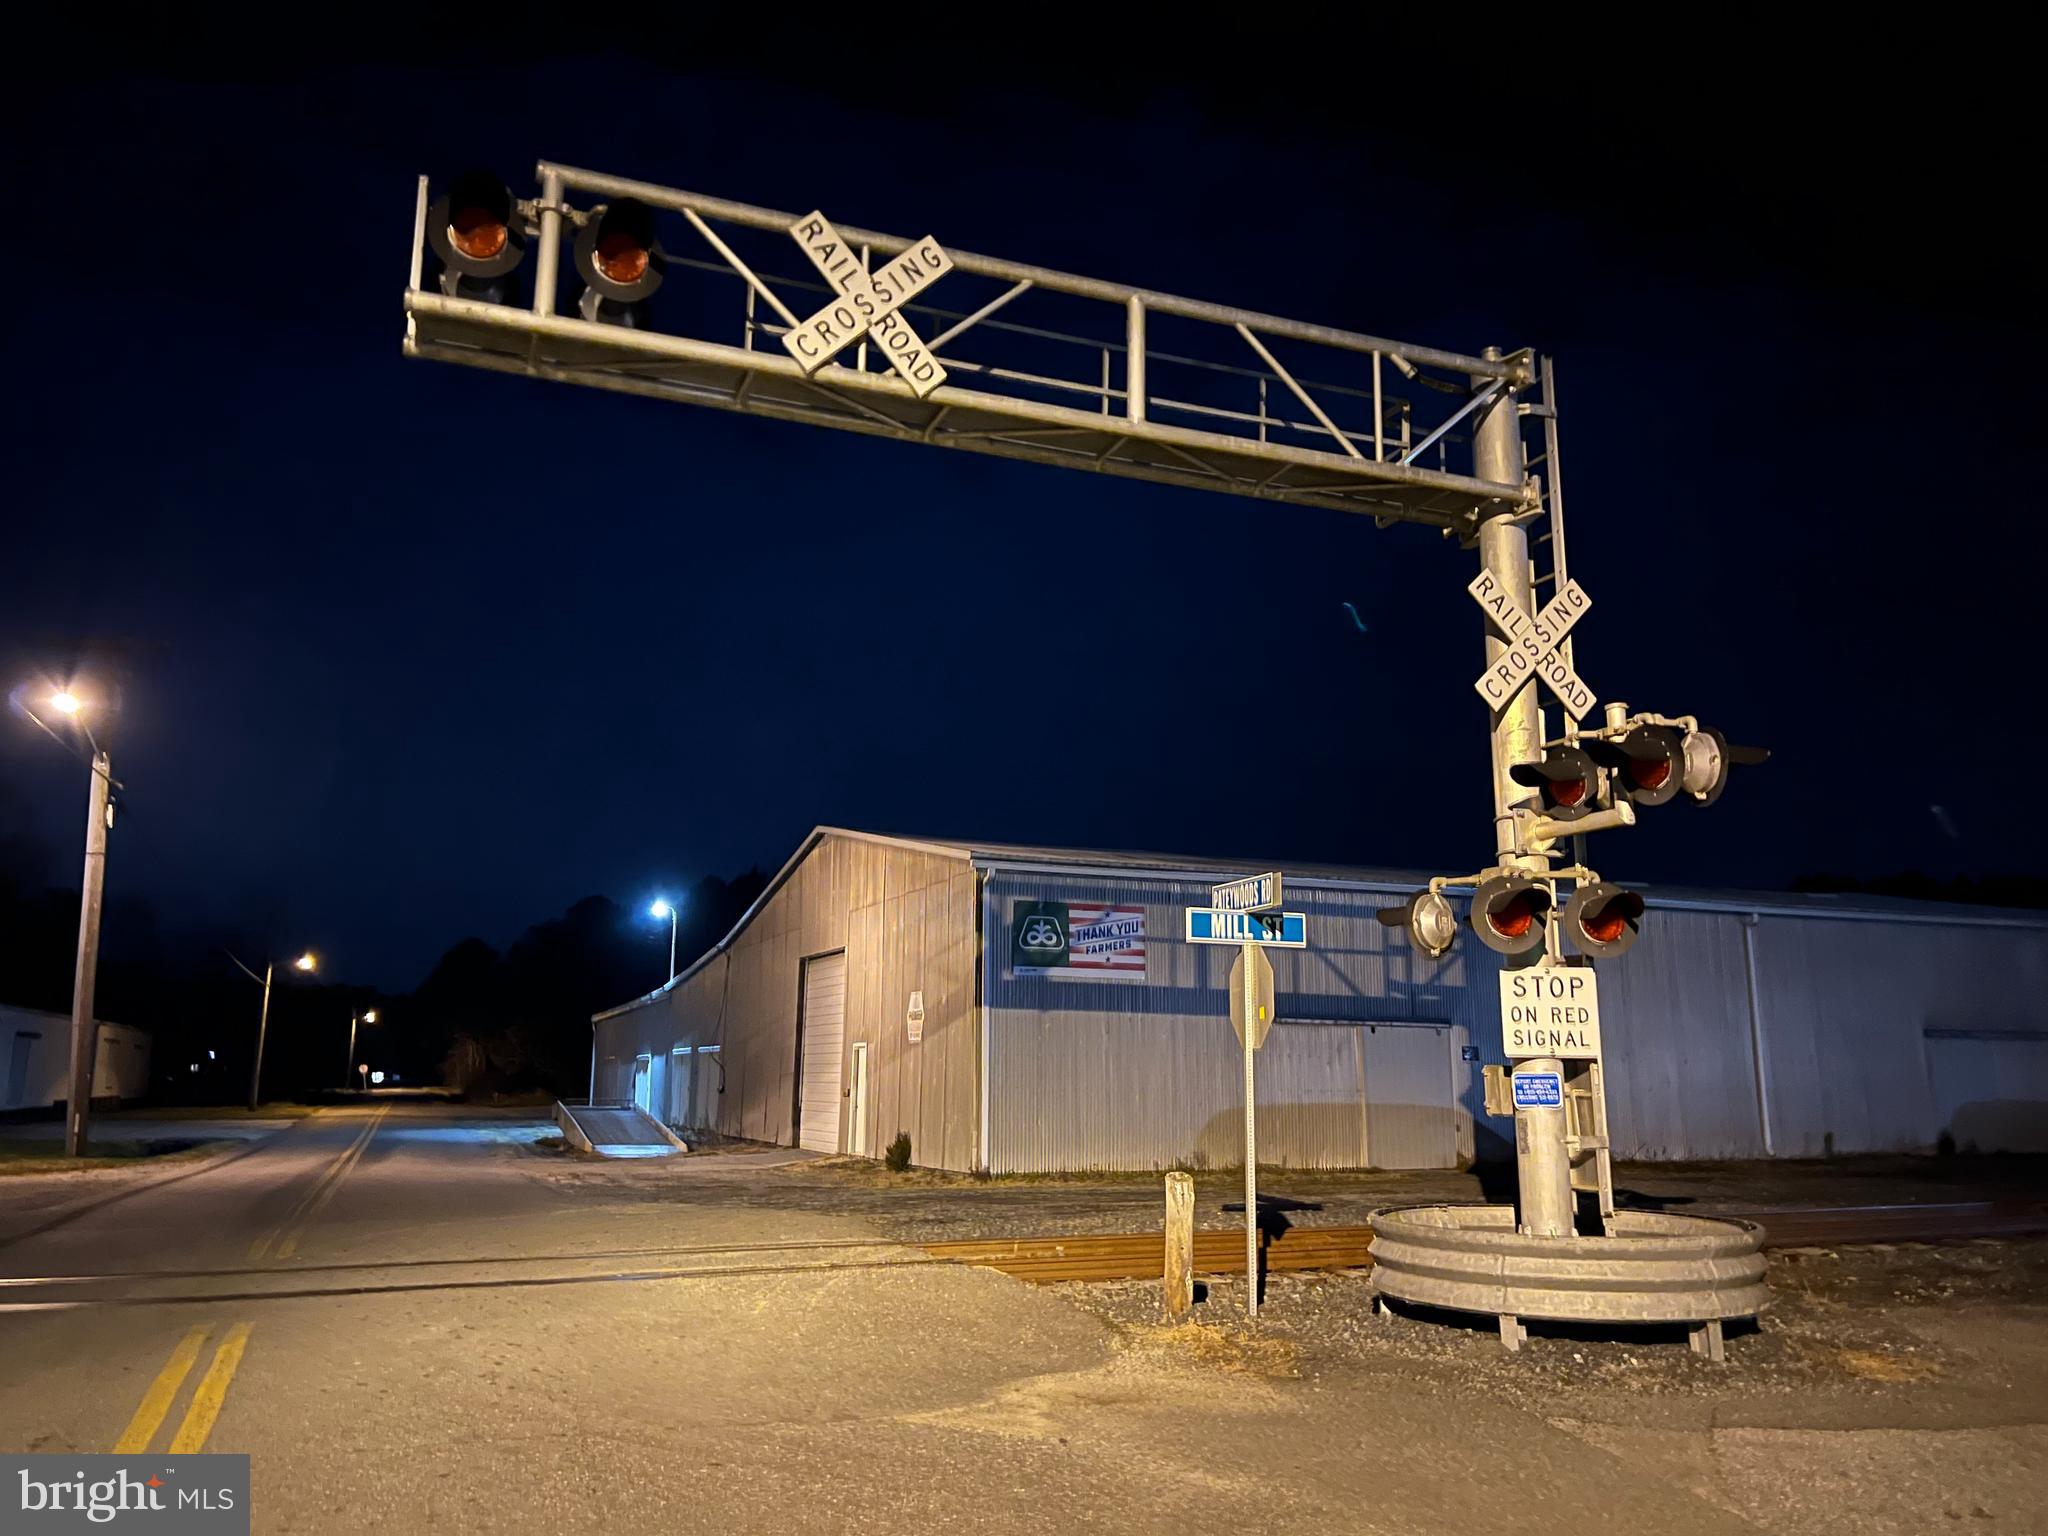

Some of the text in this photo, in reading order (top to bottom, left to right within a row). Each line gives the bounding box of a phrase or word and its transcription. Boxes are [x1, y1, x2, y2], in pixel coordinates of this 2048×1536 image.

[796, 246, 941, 357] CROSSING
[799, 219, 935, 382] RAIL ROAD
[1476, 576, 1588, 708] RAIL ROAD
[1485, 588, 1583, 699] CROSSING
[1261, 878, 1271, 905] RD
[1076, 920, 1139, 941] THANK YOU
[1211, 913, 1283, 941] MILL ST
[1086, 939, 1132, 955] FARMERS
[1512, 975, 1584, 999] STOP
[1511, 1005, 1589, 1024] ON RED
[1513, 1029, 1590, 1047] SIGNAL
